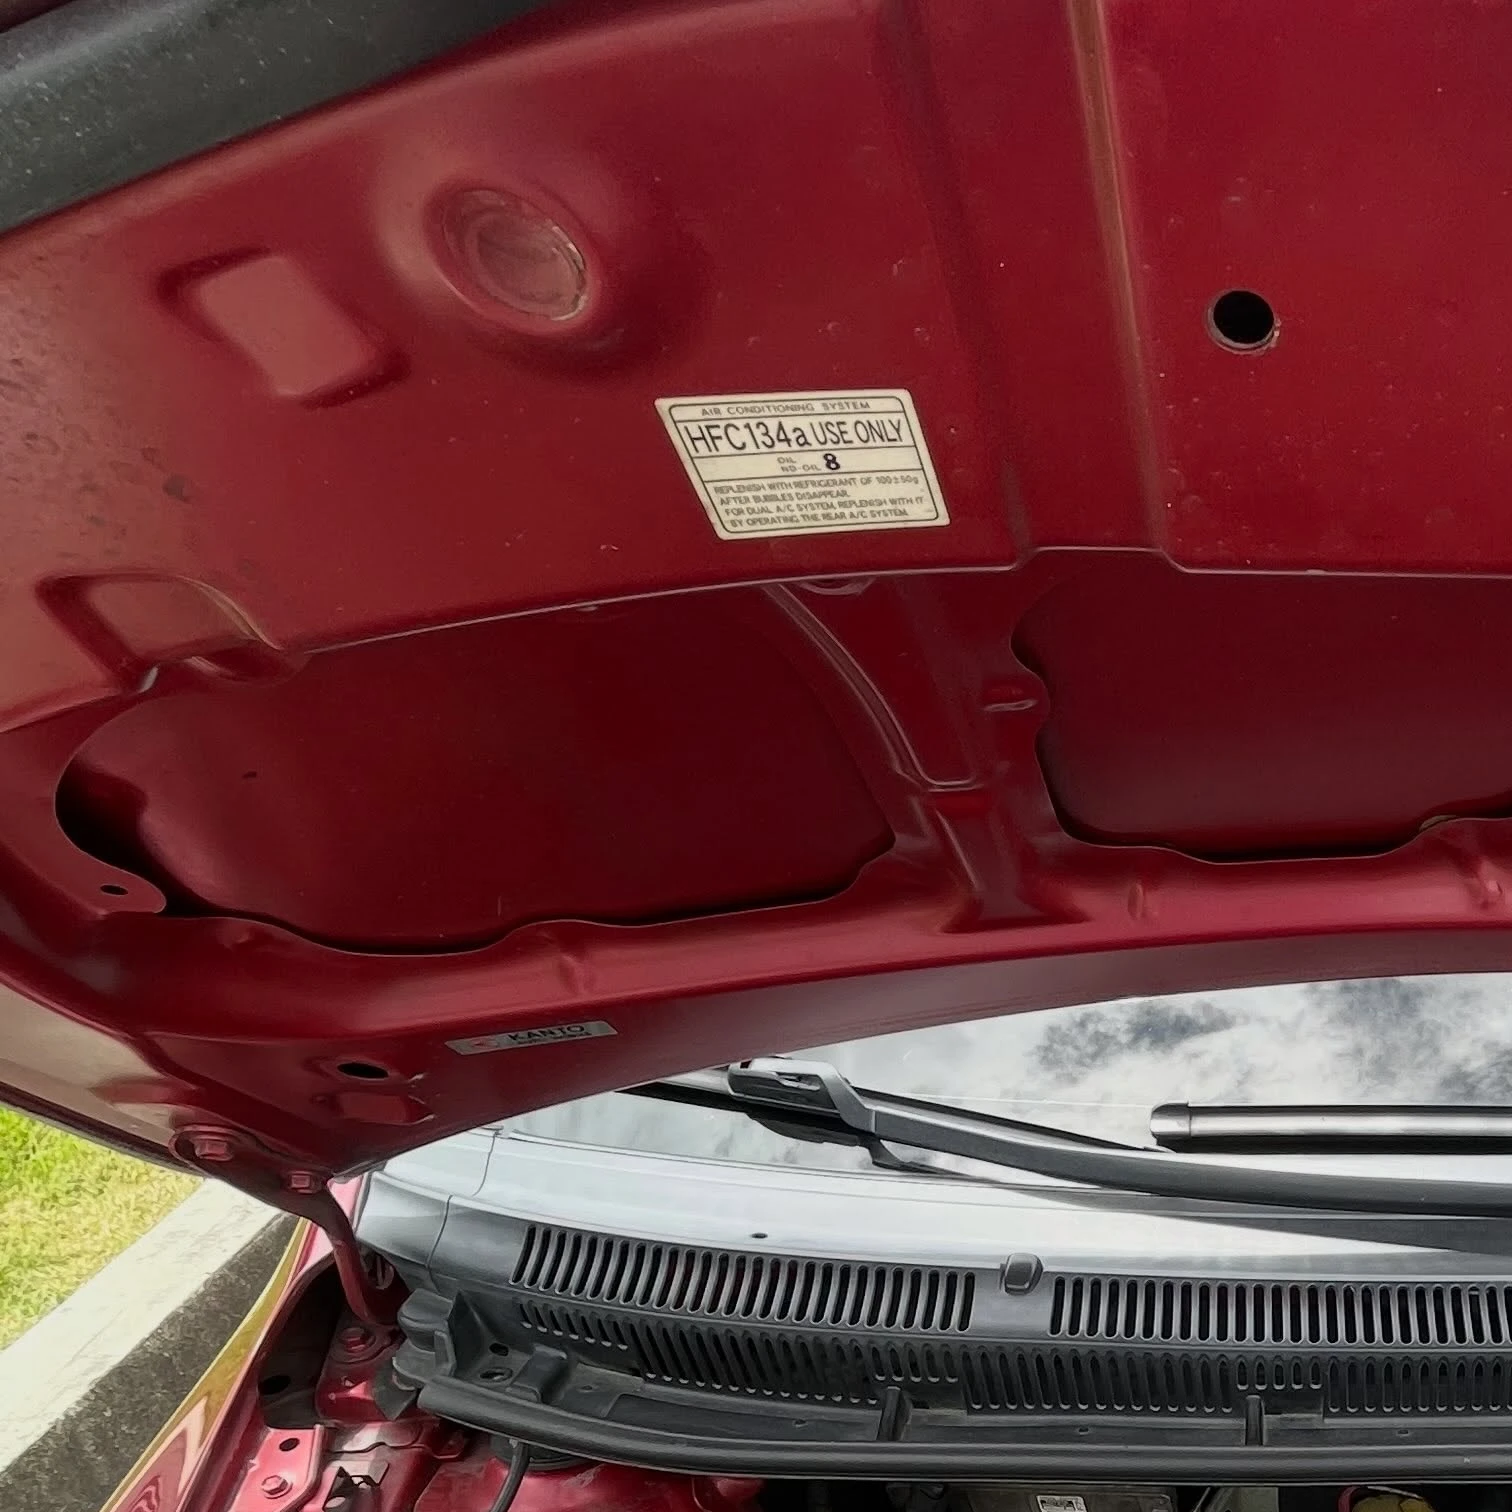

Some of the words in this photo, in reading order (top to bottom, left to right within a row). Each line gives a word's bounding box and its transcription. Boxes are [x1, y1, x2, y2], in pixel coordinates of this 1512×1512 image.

[701, 407, 721, 417] AIR
[727, 403, 815, 416] CONDITIONING
[823, 401, 871, 412] SYSTEM
[684, 420, 812, 453] HFC134a
[812, 421, 853, 446] USE
[854, 418, 904, 443] ONLY
[822, 453, 841, 470] 8
[720, 496, 751, 506] AFTER
[724, 507, 745, 516] FOR
[746, 506, 774, 515] DUAL
[776, 504, 795, 513] A/C
[888, 497, 914, 506] WITH
[730, 519, 744, 528] BY
[849, 510, 868, 519] A/C
[508, 1024, 585, 1041] KANTO
